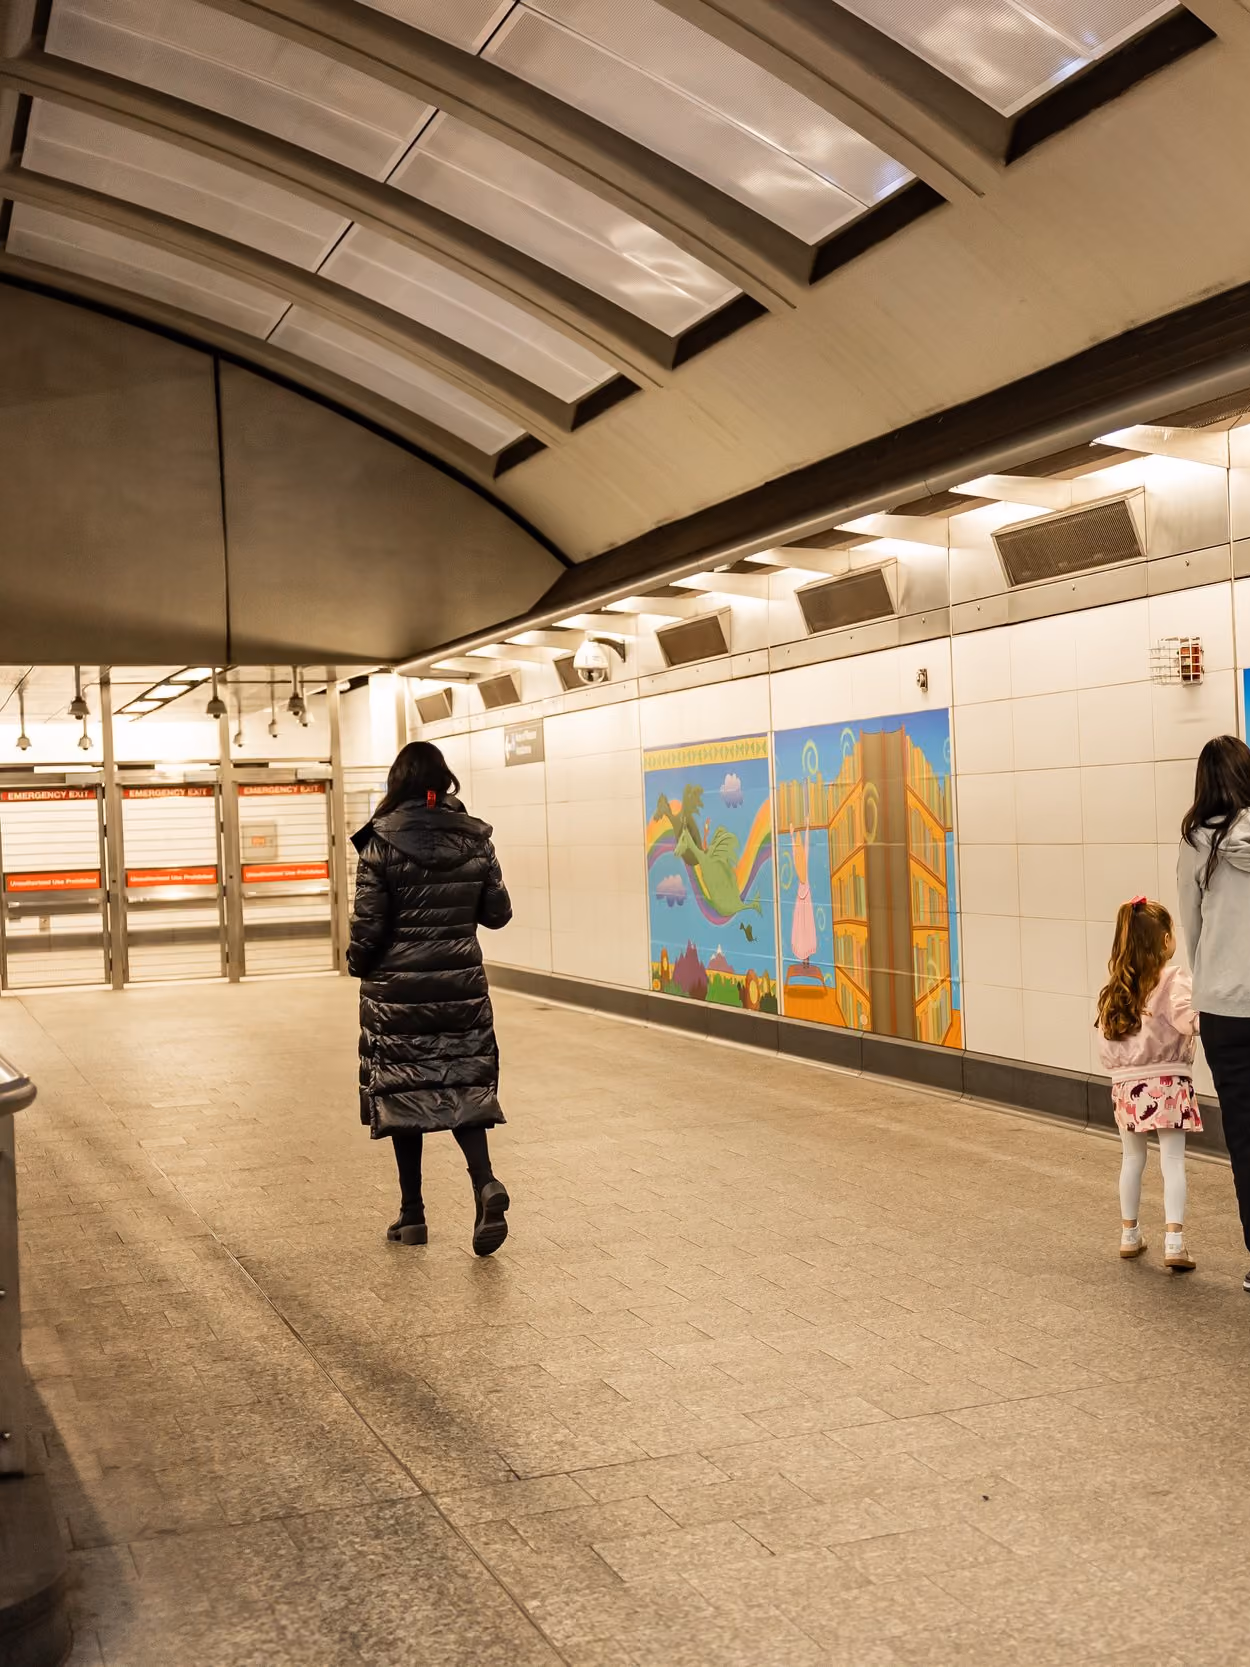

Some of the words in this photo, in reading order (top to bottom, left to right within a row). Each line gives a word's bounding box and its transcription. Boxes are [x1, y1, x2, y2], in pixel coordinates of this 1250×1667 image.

[129, 788, 186, 797] EMERGENCY
[187, 788, 207, 796] EXIT
[243, 786, 298, 795] EMERGENCY
[300, 784, 320, 793] EXIT
[8, 791, 67, 800] EMERGENCY
[68, 790, 88, 798] EXIT
